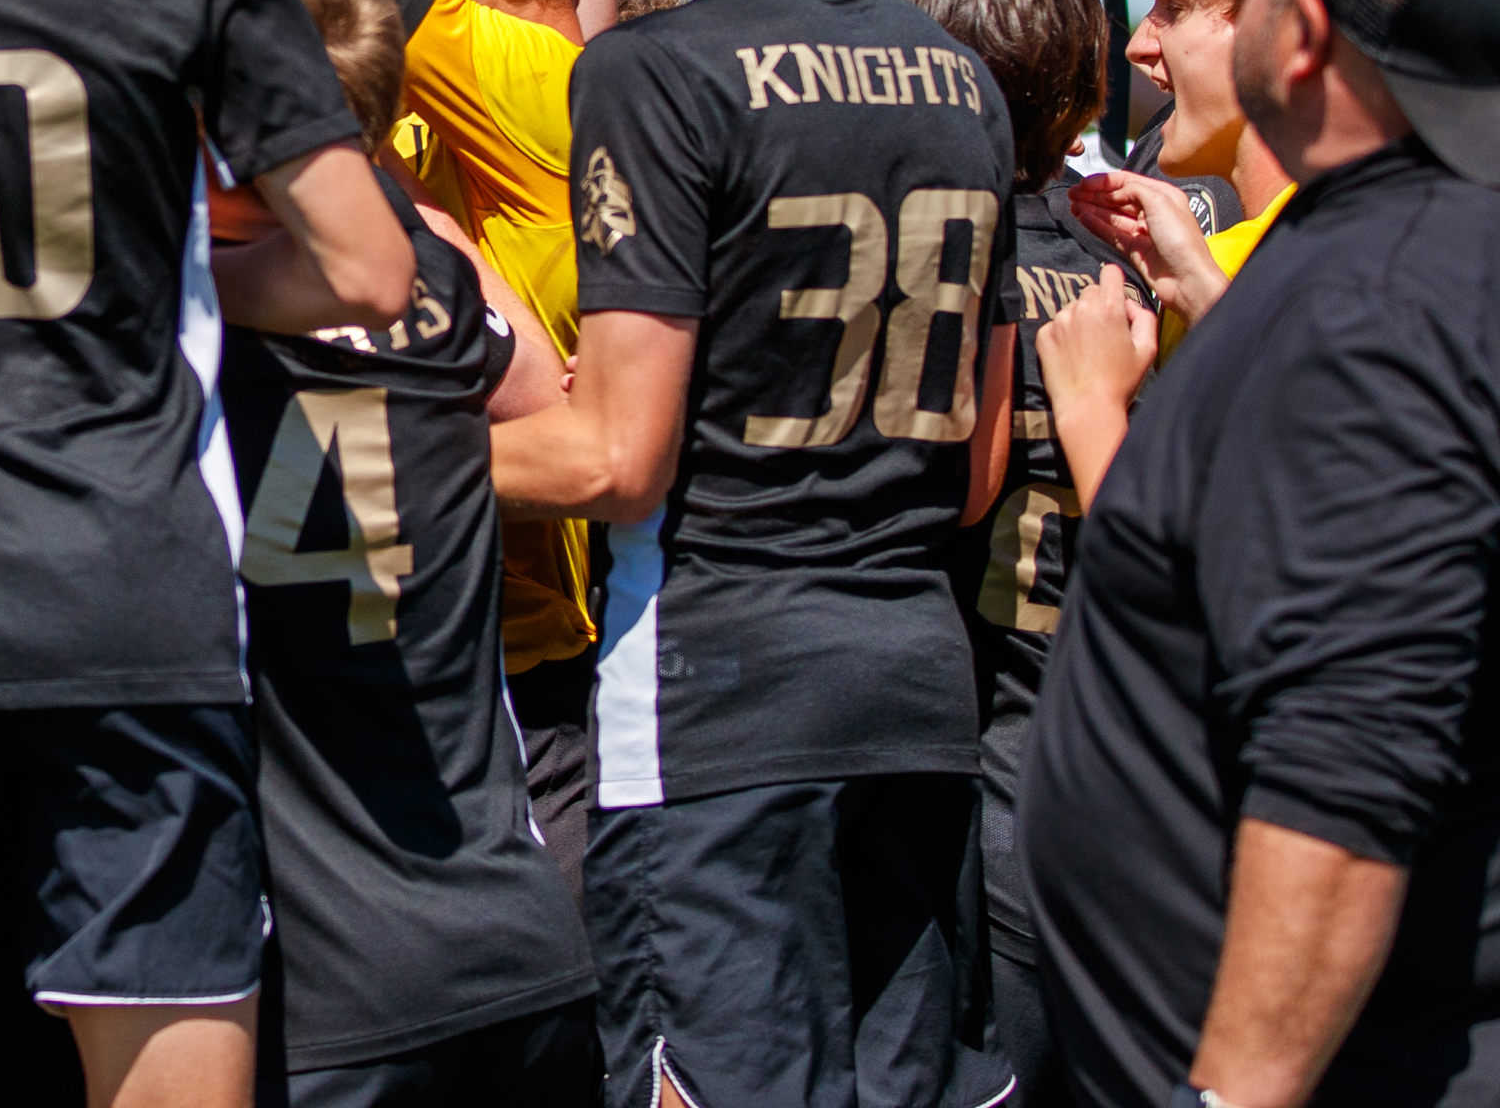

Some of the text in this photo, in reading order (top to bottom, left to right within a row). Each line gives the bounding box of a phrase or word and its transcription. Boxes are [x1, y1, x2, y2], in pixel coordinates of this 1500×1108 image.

[736, 43, 983, 115] KNIGHTS
[743, 188, 999, 448] 38
[240, 387, 414, 647] 4
